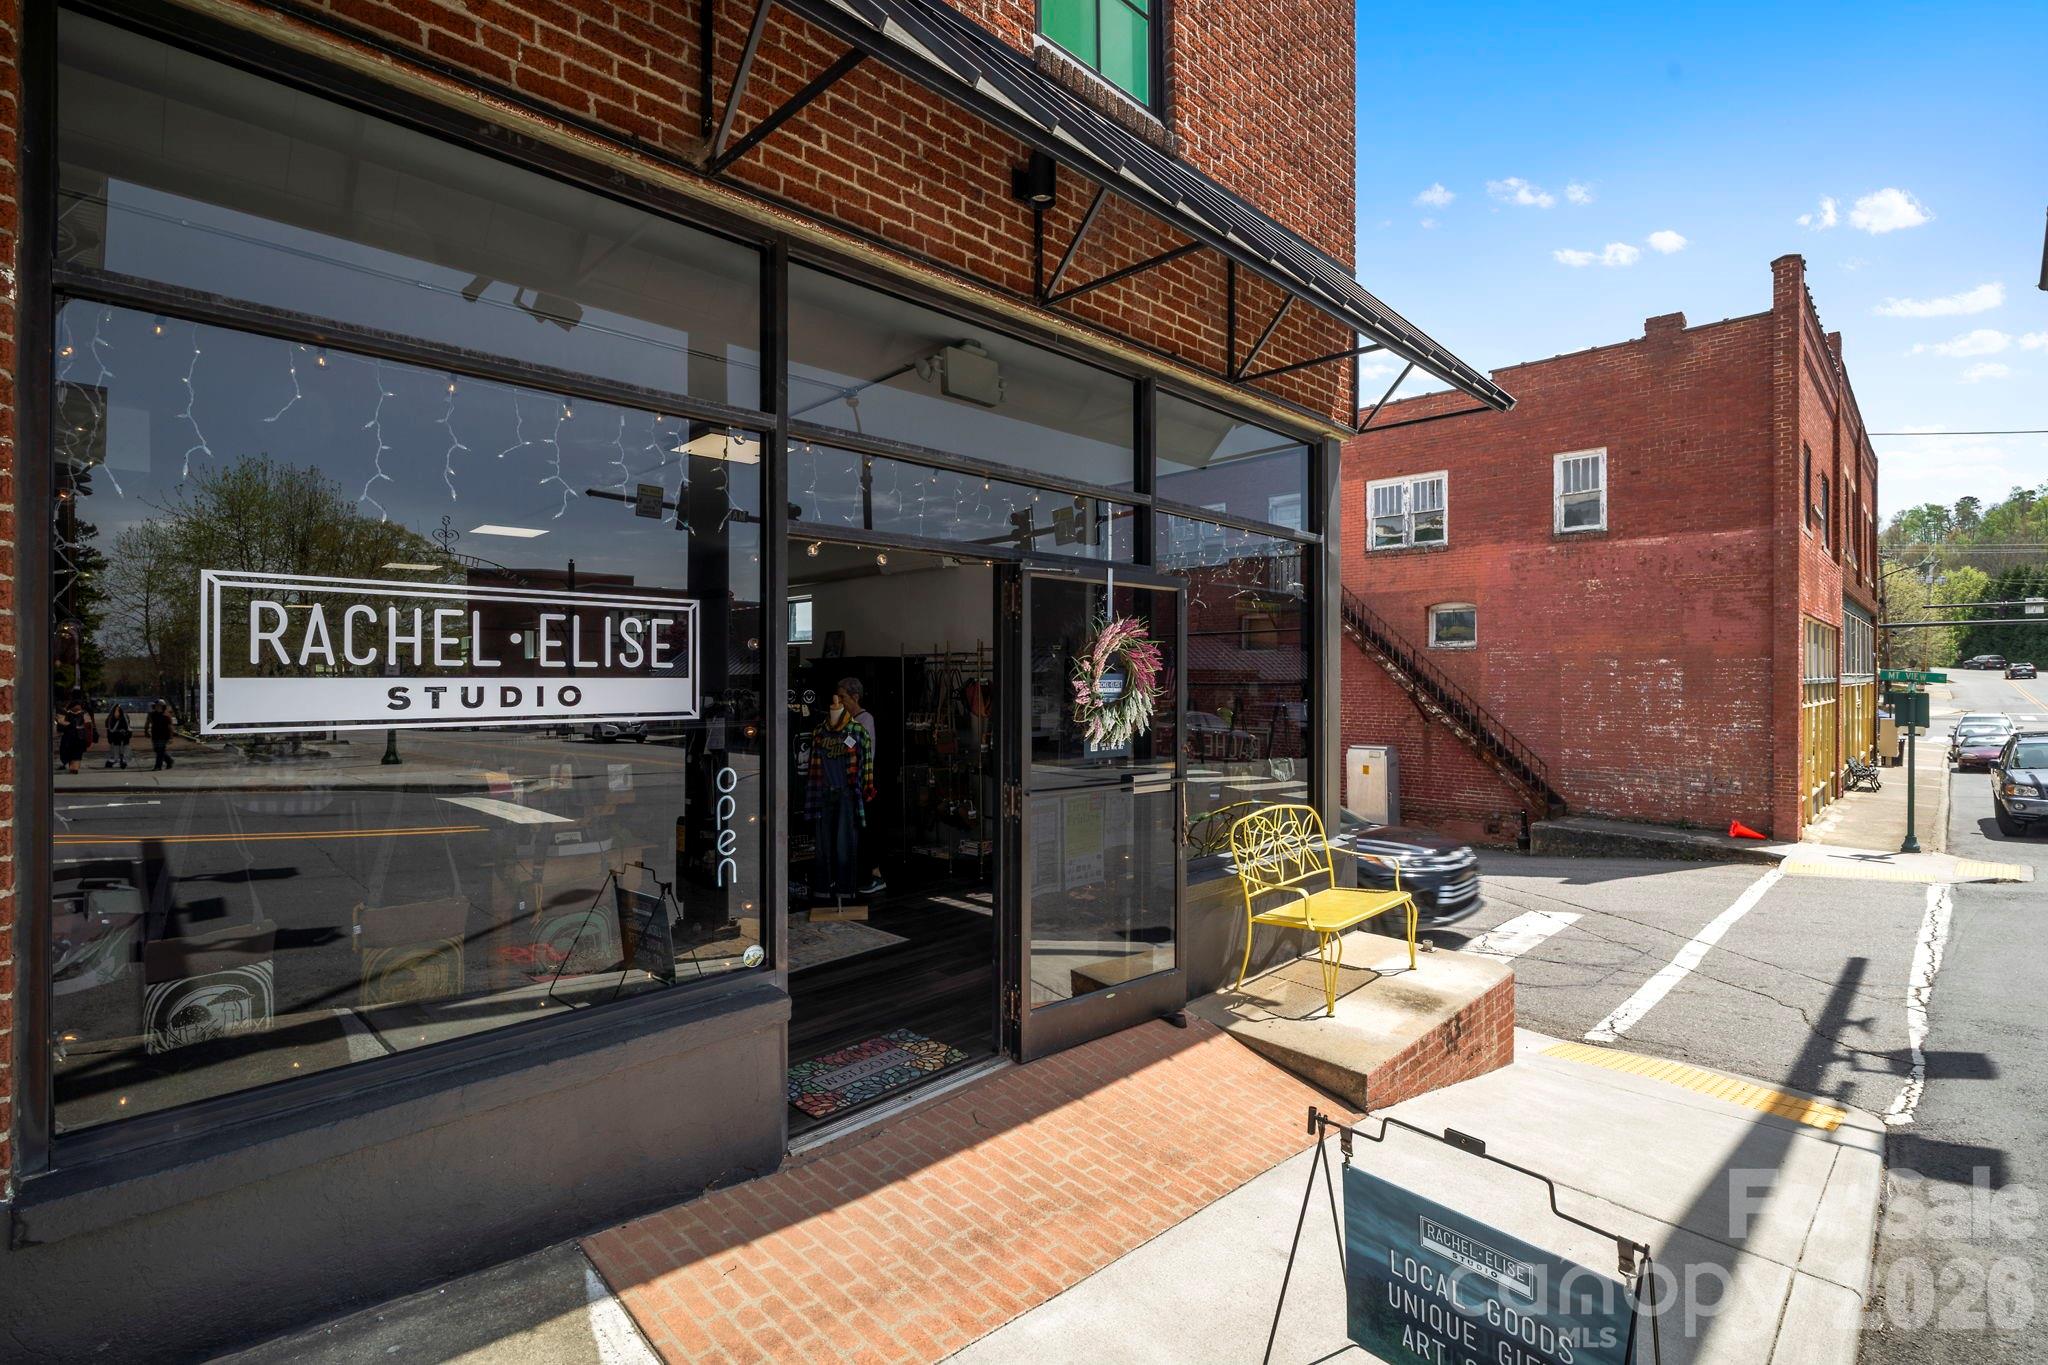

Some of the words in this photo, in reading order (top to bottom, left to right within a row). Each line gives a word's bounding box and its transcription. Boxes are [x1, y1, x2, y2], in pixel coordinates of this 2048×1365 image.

[250, 600, 501, 668] RACHEL
[539, 613, 674, 669] ELISE
[387, 685, 582, 711] STUDIO
[1888, 671, 1900, 680] MT
[1905, 672, 1927, 681] VIEW
[716, 767, 738, 887] open
[820, 1050, 911, 1086] WELCOME
[1427, 1224, 1478, 1259] RACHEL
[1485, 1251, 1525, 1282] ELISE
[1452, 1252, 1498, 1278] STUDIO
[1388, 1282, 1477, 1351] UNIQUE
[1390, 1250, 1466, 1310] LOCAL
[1487, 1298, 1574, 1365] GOODS
[1402, 1324, 1447, 1365] ART
